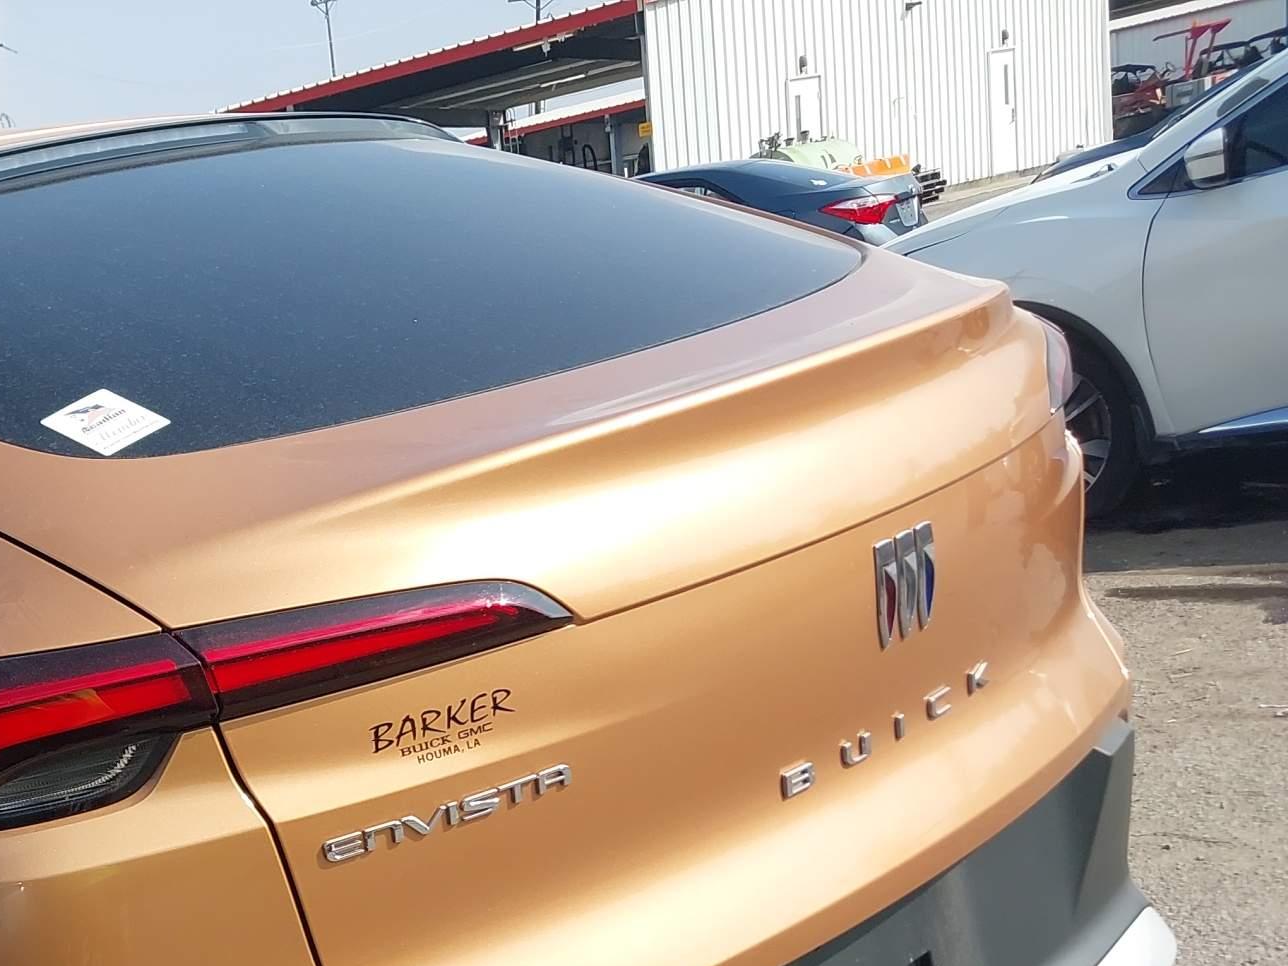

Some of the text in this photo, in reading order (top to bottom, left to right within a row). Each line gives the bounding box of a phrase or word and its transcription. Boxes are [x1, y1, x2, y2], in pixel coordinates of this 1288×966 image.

[368, 688, 516, 754] BARKER
[400, 721, 494, 758] BUICK GMC
[416, 738, 481, 765] HOUMA, LA
[780, 660, 989, 801] BUICK
[322, 763, 573, 863] ENVISTA
